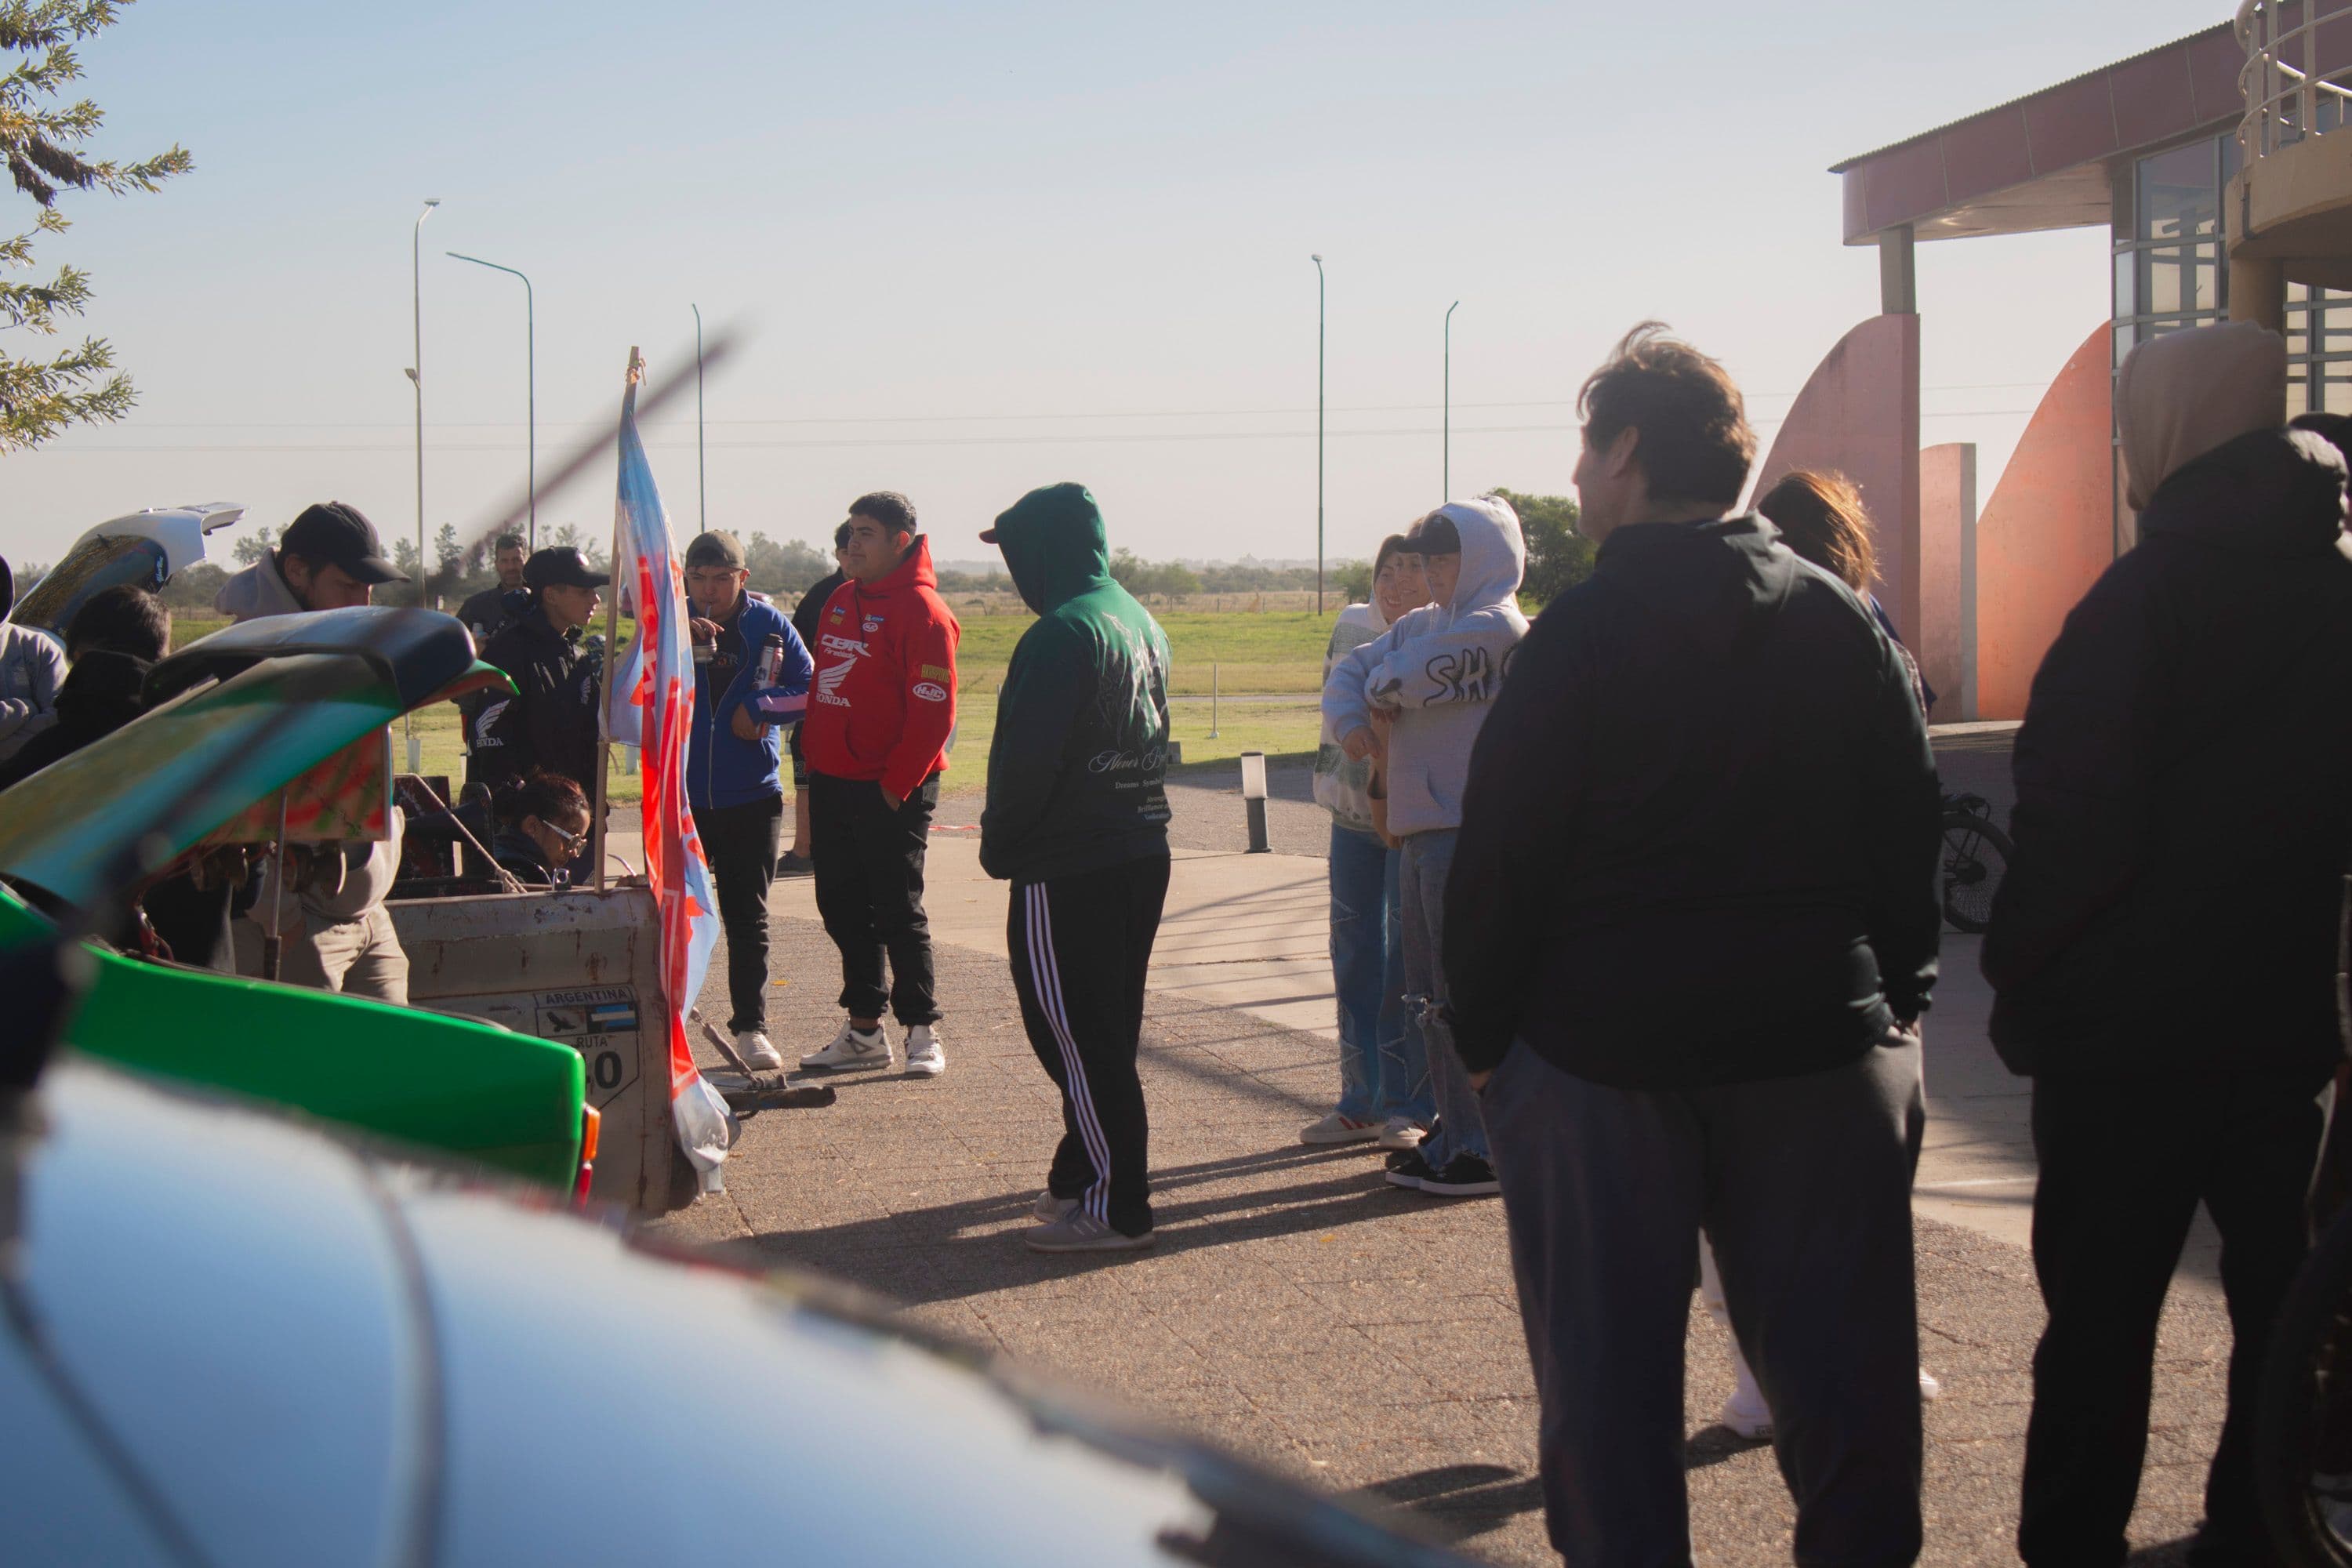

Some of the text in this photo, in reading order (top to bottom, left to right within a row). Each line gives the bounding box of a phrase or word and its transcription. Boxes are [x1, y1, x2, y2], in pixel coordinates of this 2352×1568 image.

[821, 633, 871, 657] CBR
[546, 988, 628, 1004] ARGENTINA
[576, 1036, 608, 1048] RUTA
[586, 1051, 622, 1090] 0
